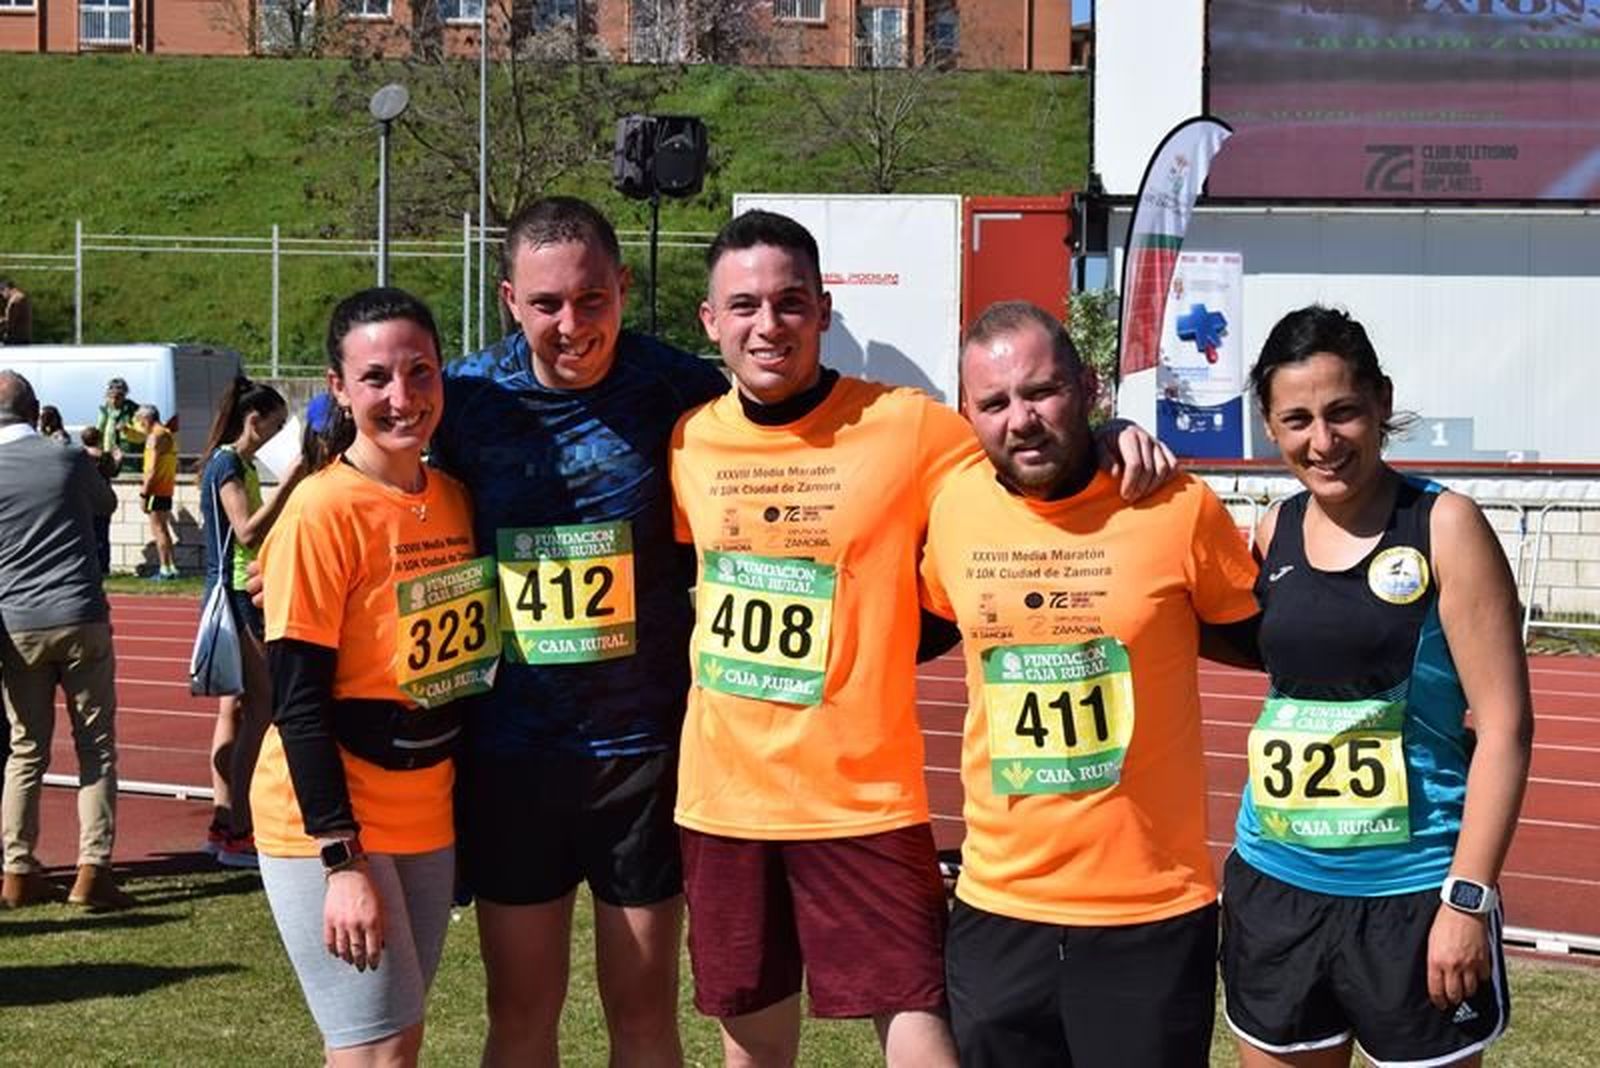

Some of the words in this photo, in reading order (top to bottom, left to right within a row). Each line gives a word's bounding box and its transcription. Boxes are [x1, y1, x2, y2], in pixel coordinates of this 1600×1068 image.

[1431, 423, 1449, 447] 1
[753, 467, 785, 478] Media
[788, 465, 836, 477] Maratón
[742, 484, 778, 495] Ciudad
[781, 483, 795, 494] de
[797, 482, 841, 493] Zamora
[569, 542, 617, 557] RURAL
[1011, 549, 1048, 561] Media
[1050, 548, 1105, 561] Maratón
[975, 568, 996, 579] 10K
[999, 567, 1041, 579] Ciudad
[1043, 566, 1060, 578] de
[1063, 565, 1113, 578] Zamora
[516, 565, 615, 622] 412
[737, 573, 765, 590] CAJA
[767, 576, 816, 594] RURAL
[407, 600, 487, 671] 323
[711, 593, 814, 660] 408
[537, 638, 577, 654] CAJA
[580, 633, 629, 651] RURAL
[1025, 667, 1058, 681] CAJA
[1060, 659, 1111, 679] RURAL
[724, 668, 759, 687] CAJA
[761, 674, 815, 695] RURAL
[1015, 685, 1109, 748] 411
[1035, 768, 1076, 784] CAJA
[1263, 739, 1386, 798] 325
[1291, 820, 1333, 836] CAJA
[1337, 817, 1400, 834] RURAL
